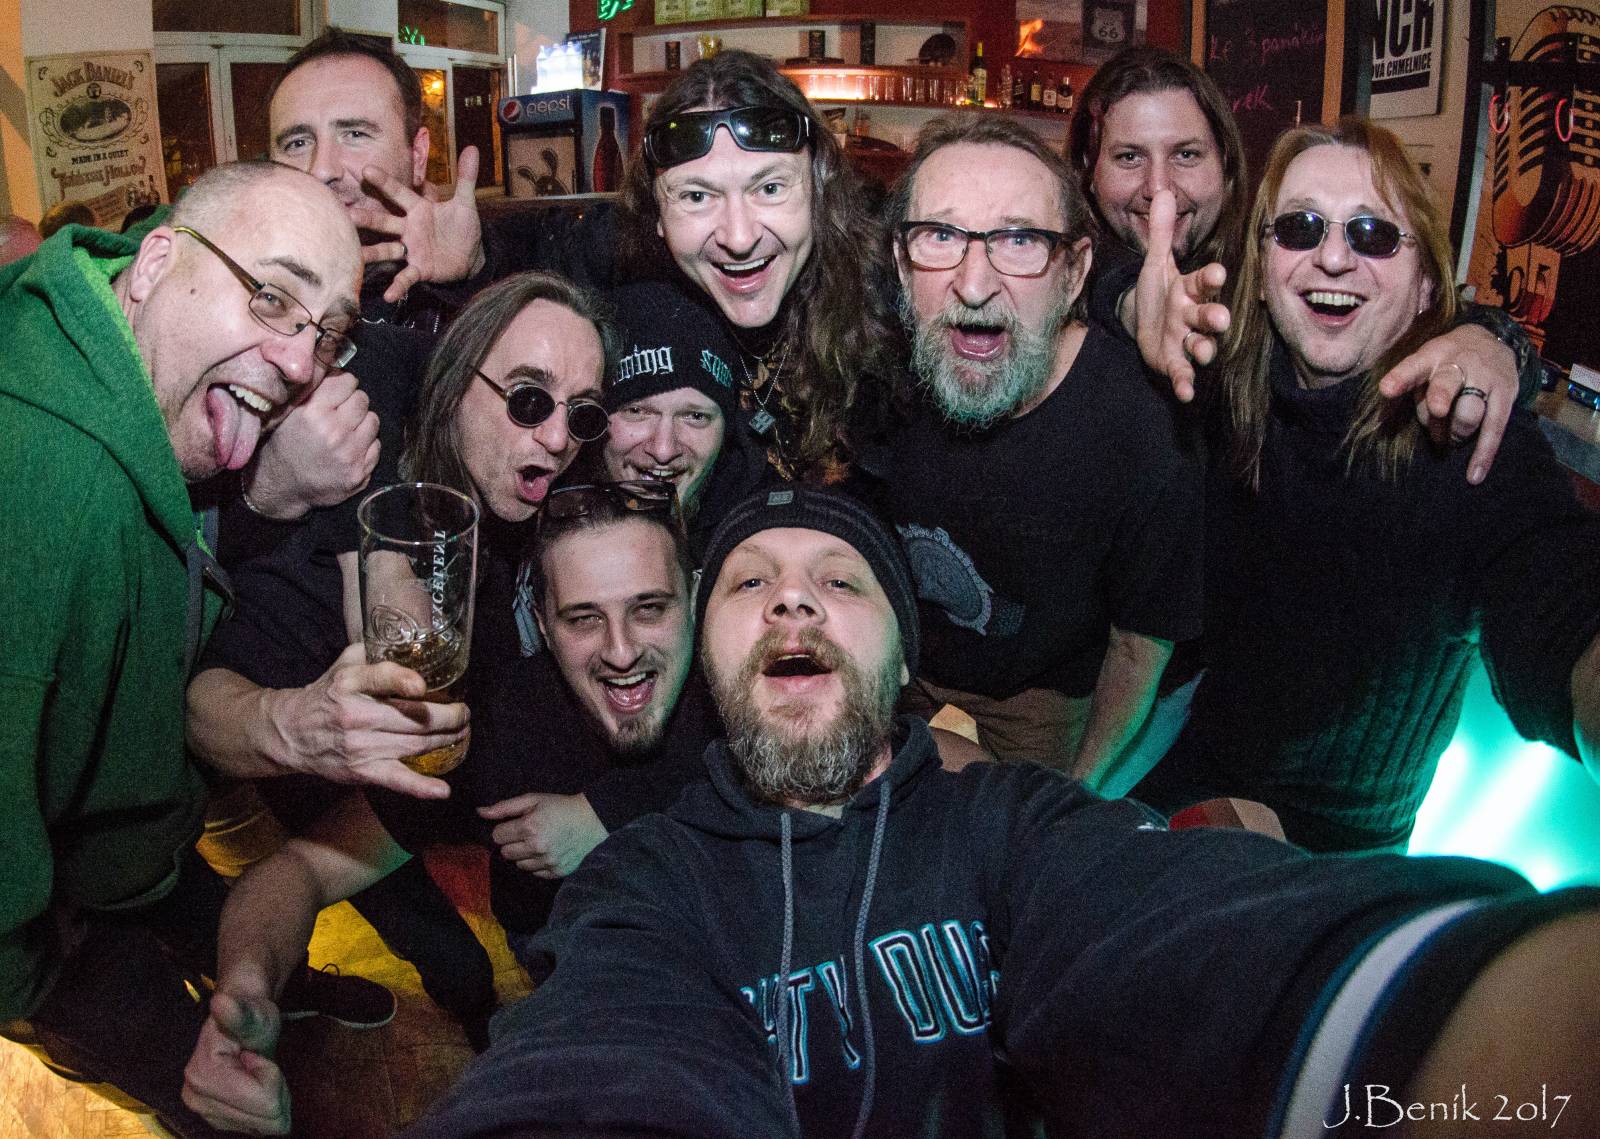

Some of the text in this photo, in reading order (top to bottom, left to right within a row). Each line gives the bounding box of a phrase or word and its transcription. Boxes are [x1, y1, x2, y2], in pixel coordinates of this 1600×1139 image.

[1387, 52, 1432, 76] CHMELNICE
[50, 68, 84, 97] JACK
[526, 95, 571, 117] pepsi
[71, 154, 92, 165] MADE
[107, 149, 129, 159] QUIET
